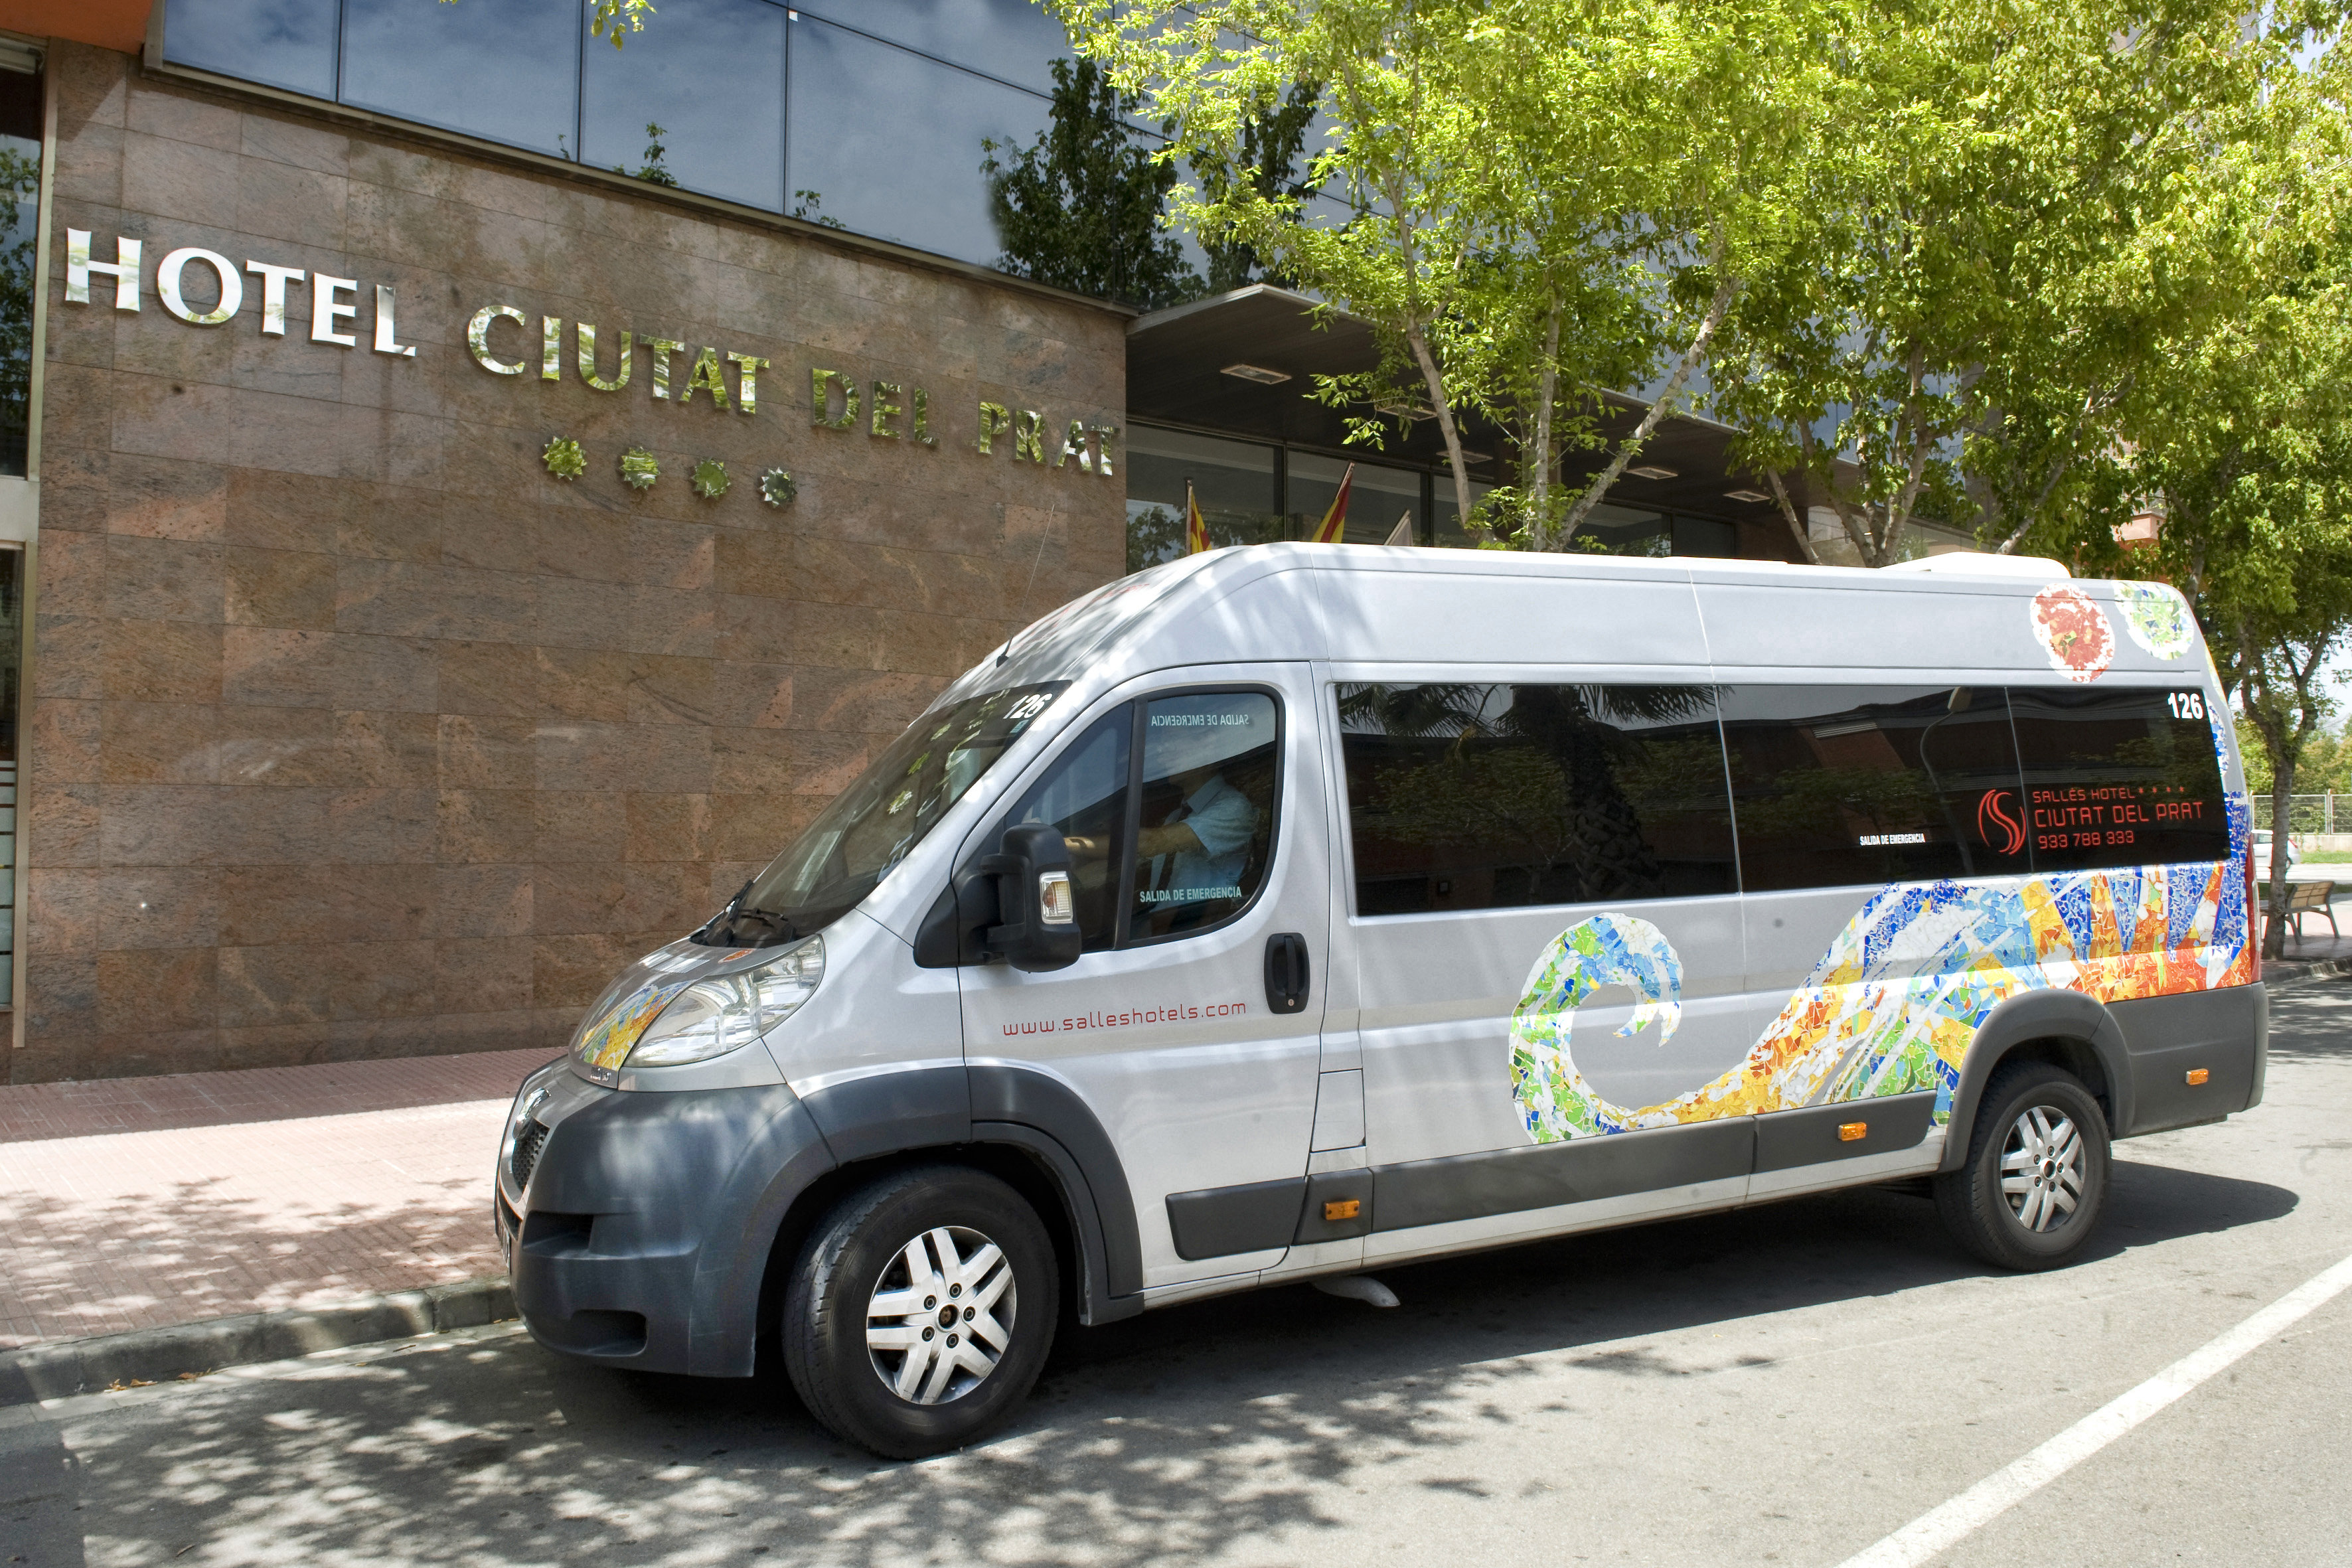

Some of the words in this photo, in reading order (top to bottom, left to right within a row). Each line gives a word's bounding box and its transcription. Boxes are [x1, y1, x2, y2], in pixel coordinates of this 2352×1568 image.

[65, 227, 416, 357] HOTEL
[467, 304, 770, 416] CIUTAT
[811, 367, 938, 449] DEL
[973, 401, 1121, 477] PRAT
[1003, 693, 1053, 719] 126
[2167, 692, 2203, 720] 126
[2091, 787, 2135, 800] HOTEL
[2035, 806, 2104, 828] CIUTAT
[2112, 805, 2150, 823] DEL
[2156, 802, 2203, 821] PRAT
[1859, 835, 1881, 846] SALIDA
[1881, 834, 1889, 844] DE
[1889, 833, 1925, 844] EMERGENCIA
[2038, 834, 2068, 849] 933
[2073, 832, 2101, 846] 788
[2106, 830, 2134, 844] 333
[1140, 890, 1171, 902] SALIDA
[1173, 889, 1184, 900] DE
[1187, 886, 1242, 900] EMERGENCIA
[1003, 1002, 1247, 1036] www.salleshotels.com
